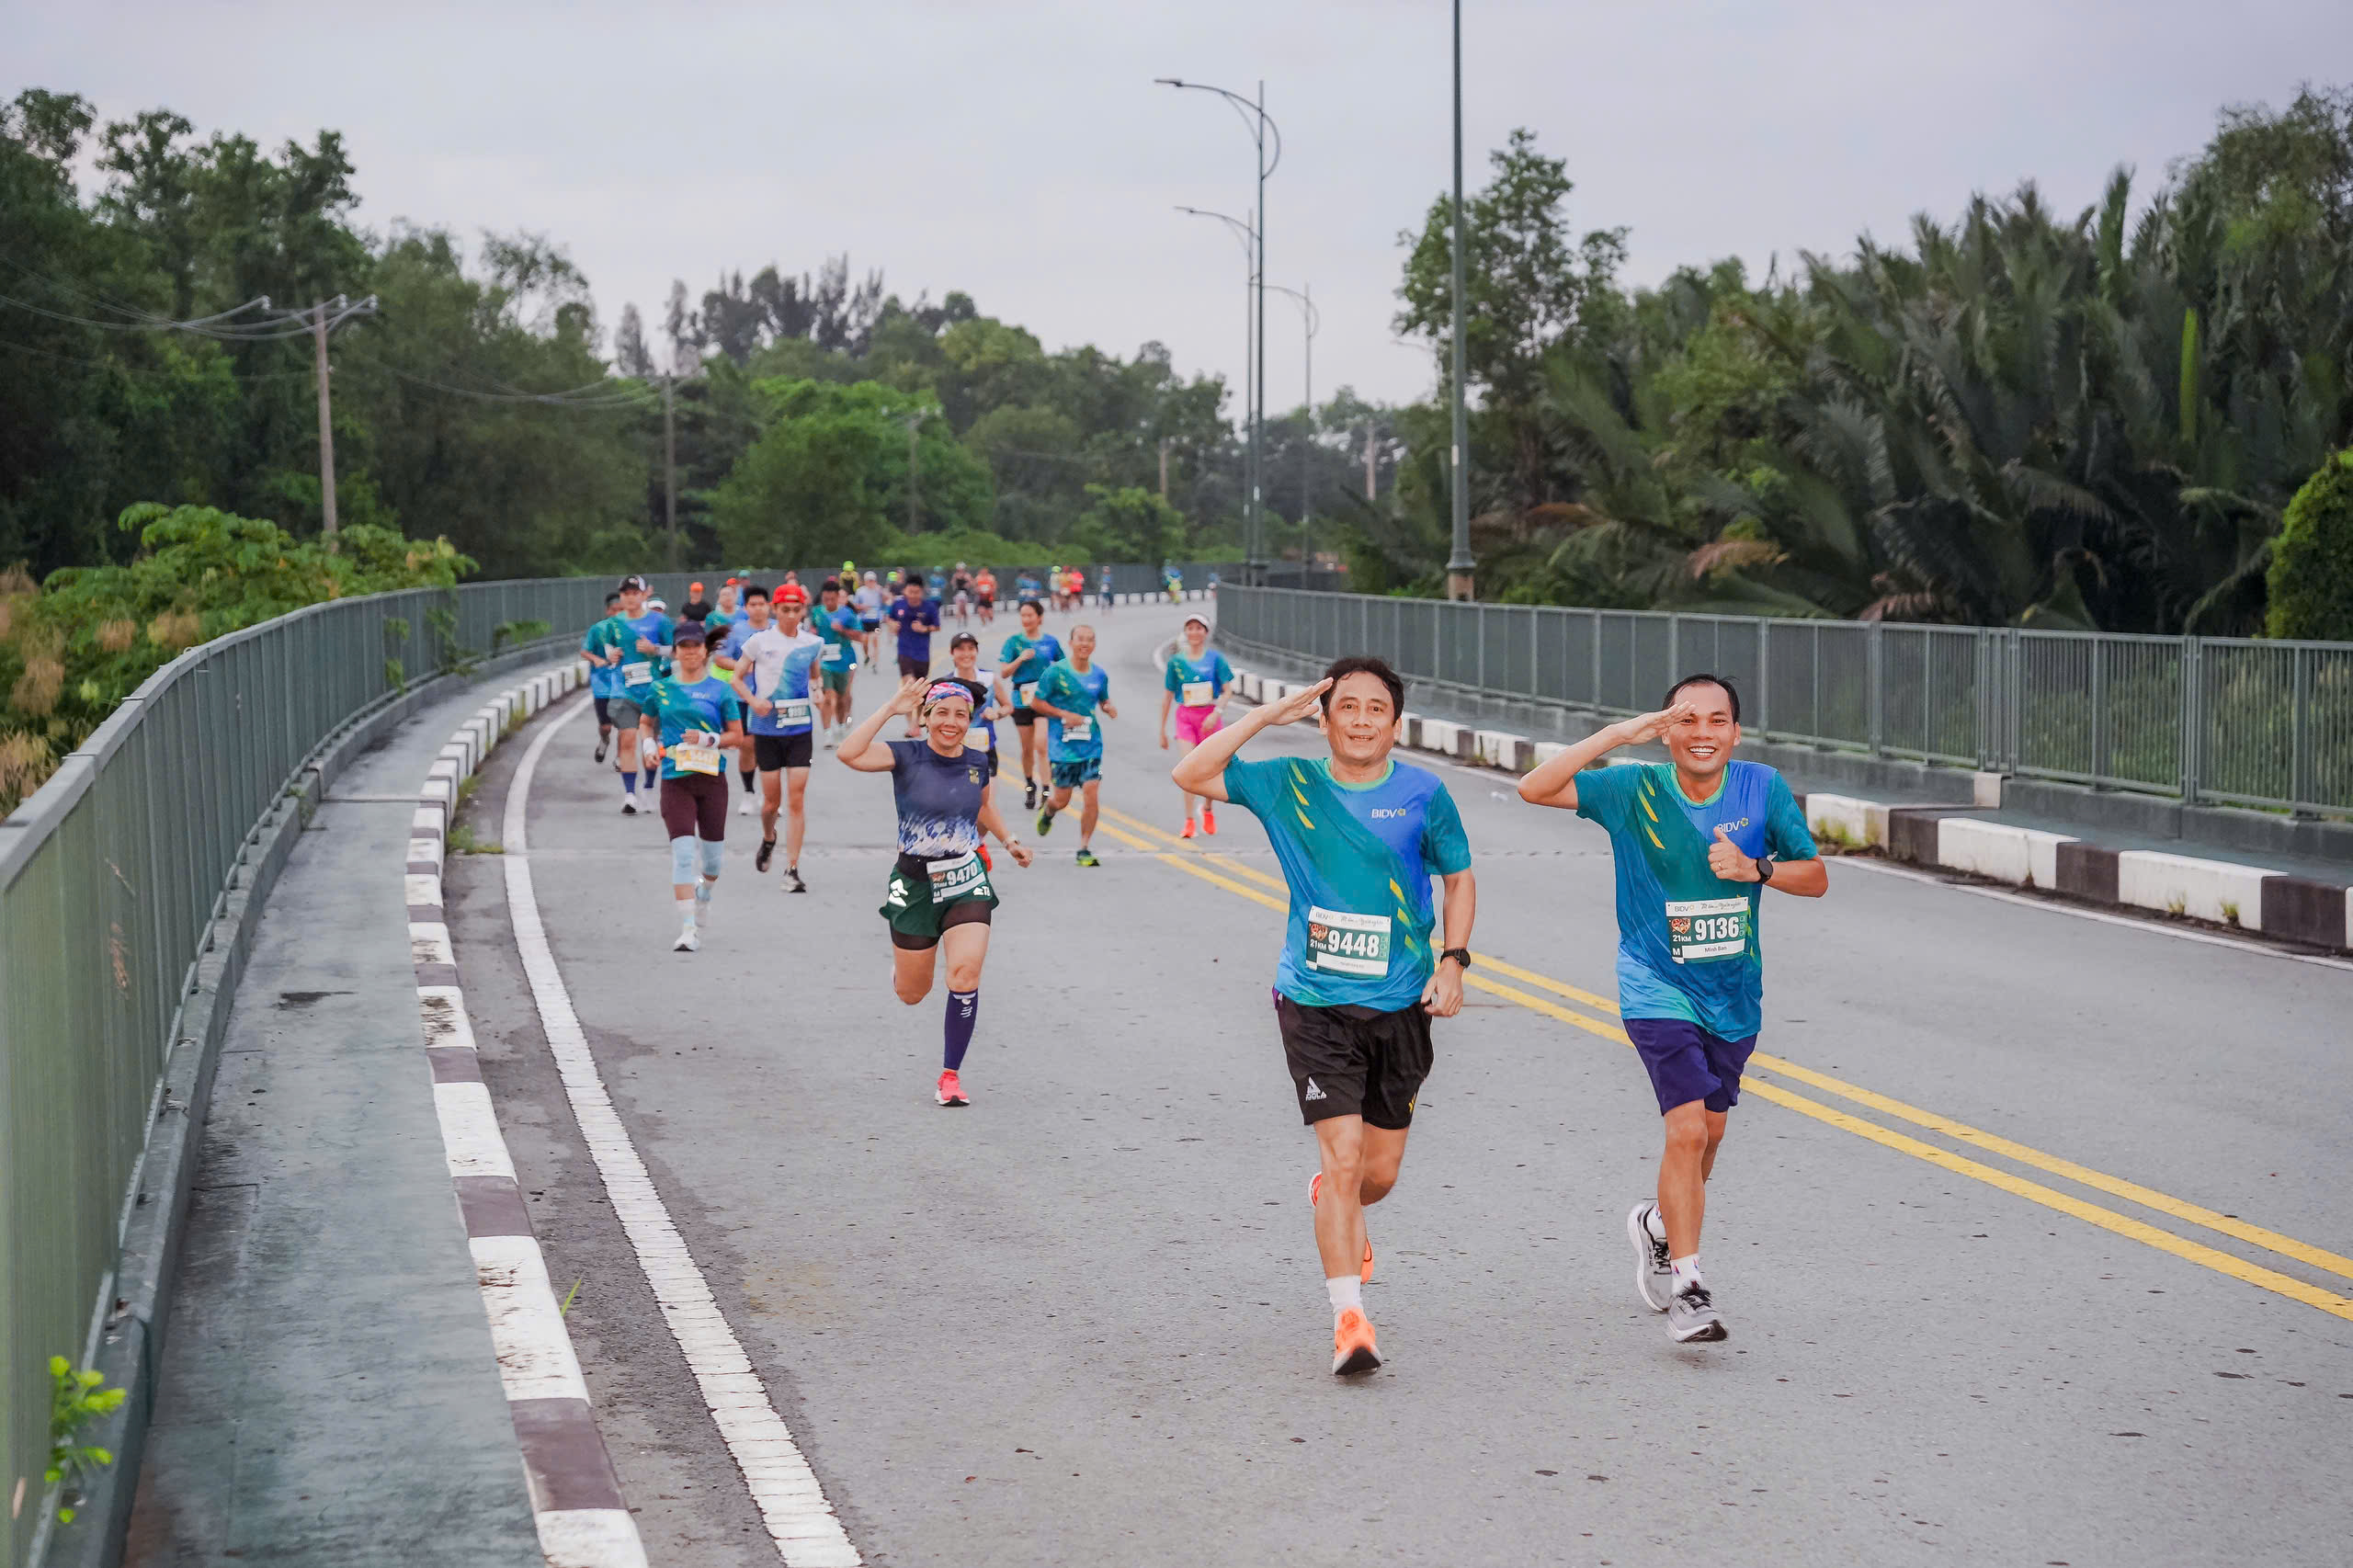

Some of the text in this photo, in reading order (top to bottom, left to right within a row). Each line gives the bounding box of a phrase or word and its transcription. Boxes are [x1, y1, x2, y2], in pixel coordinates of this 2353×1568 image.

[1371, 808, 1397, 818] BIDV
[1718, 820, 1741, 833] BIDV
[947, 861, 978, 886] 9470
[1694, 916, 1739, 941] 9136
[1310, 938, 1327, 950] 21KM
[1327, 929, 1380, 958] 9448
[1672, 948, 1680, 956] M
